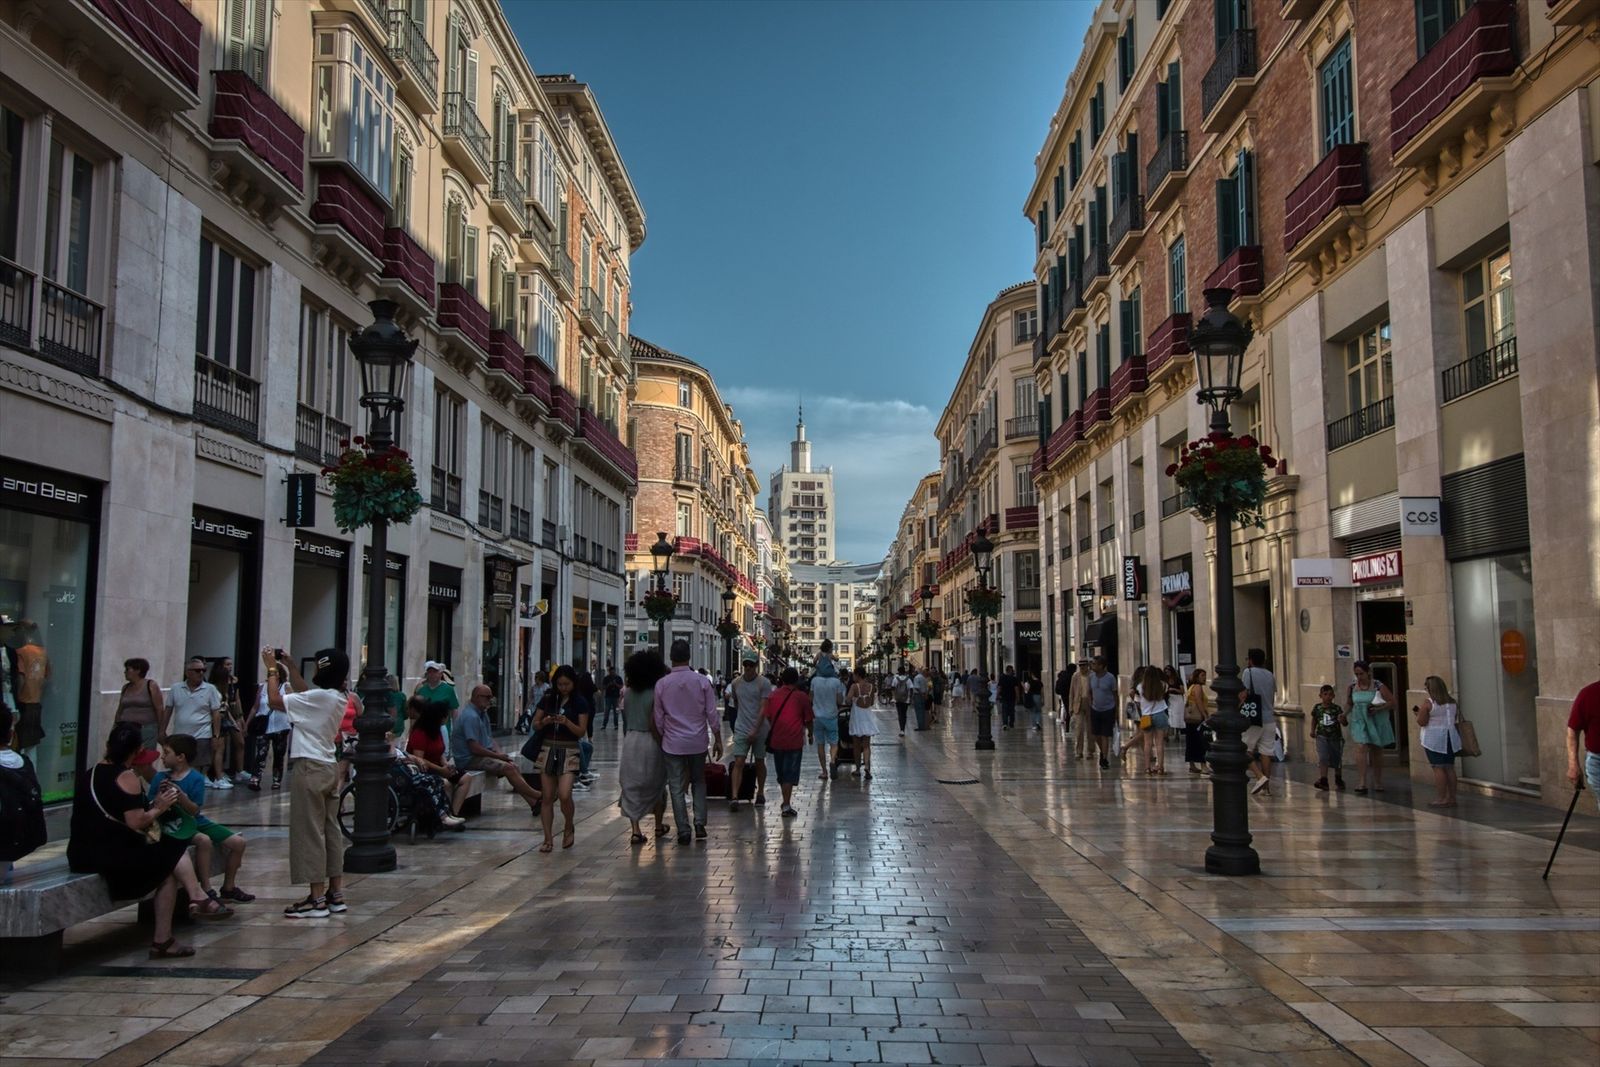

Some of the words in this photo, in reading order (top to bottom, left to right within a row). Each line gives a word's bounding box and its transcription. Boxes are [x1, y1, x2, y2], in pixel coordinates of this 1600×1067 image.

[3, 477, 37, 495] and
[41, 482, 88, 504] Bear
[1406, 511, 1439, 523] COS
[205, 522, 226, 534] and
[226, 524, 253, 539] Bear
[309, 544, 324, 555] and
[324, 545, 345, 558] Bear
[385, 559, 402, 571] Bear
[1352, 556, 1387, 581] PIKOLINOS
[1125, 559, 1135, 599] PRIMOR
[1161, 571, 1191, 594] PRIMOR
[1020, 630, 1042, 638] MANG
